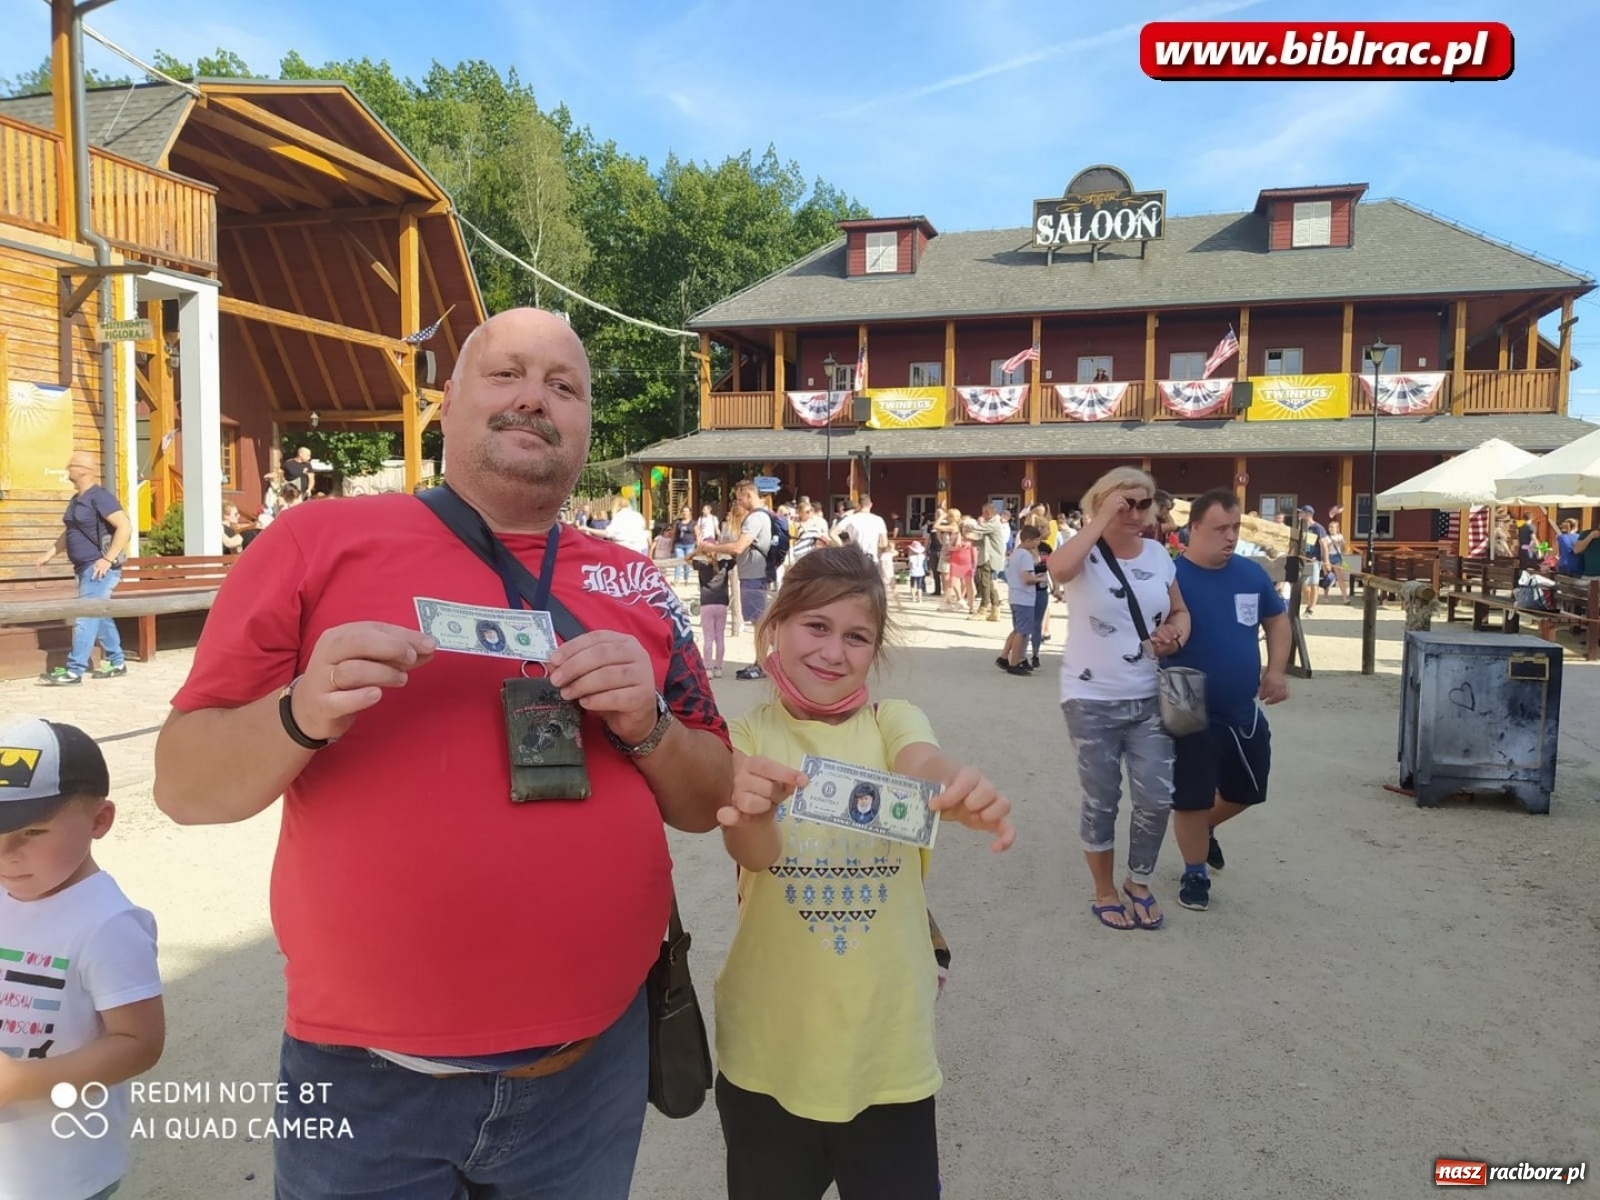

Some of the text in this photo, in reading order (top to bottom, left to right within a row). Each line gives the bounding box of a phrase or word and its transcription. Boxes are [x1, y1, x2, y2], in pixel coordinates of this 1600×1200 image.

[1036, 200, 1162, 245] SALOON
[1264, 387, 1328, 400] TWINPIGS
[879, 400, 932, 410] TWINPIGS
[26, 951, 52, 967] TOKYO
[2, 1018, 46, 1036] MOSCOW
